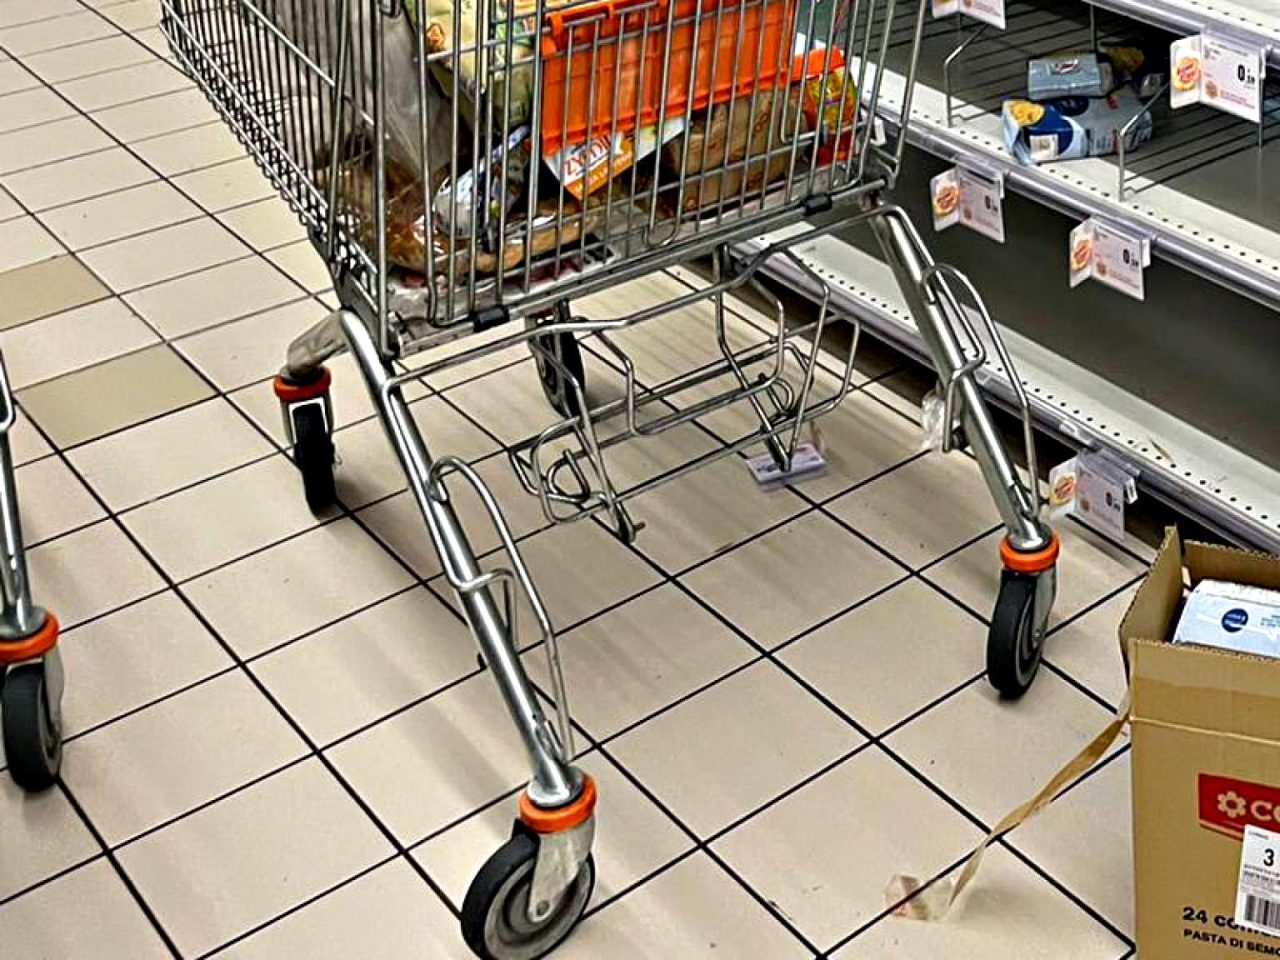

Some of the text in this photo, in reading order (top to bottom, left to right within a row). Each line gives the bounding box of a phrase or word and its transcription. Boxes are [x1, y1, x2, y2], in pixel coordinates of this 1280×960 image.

[1263, 848, 1275, 867] 3
[1183, 907, 1208, 924] 24
[1183, 928, 1227, 945] PASTA
[1229, 938, 1244, 949] DI
